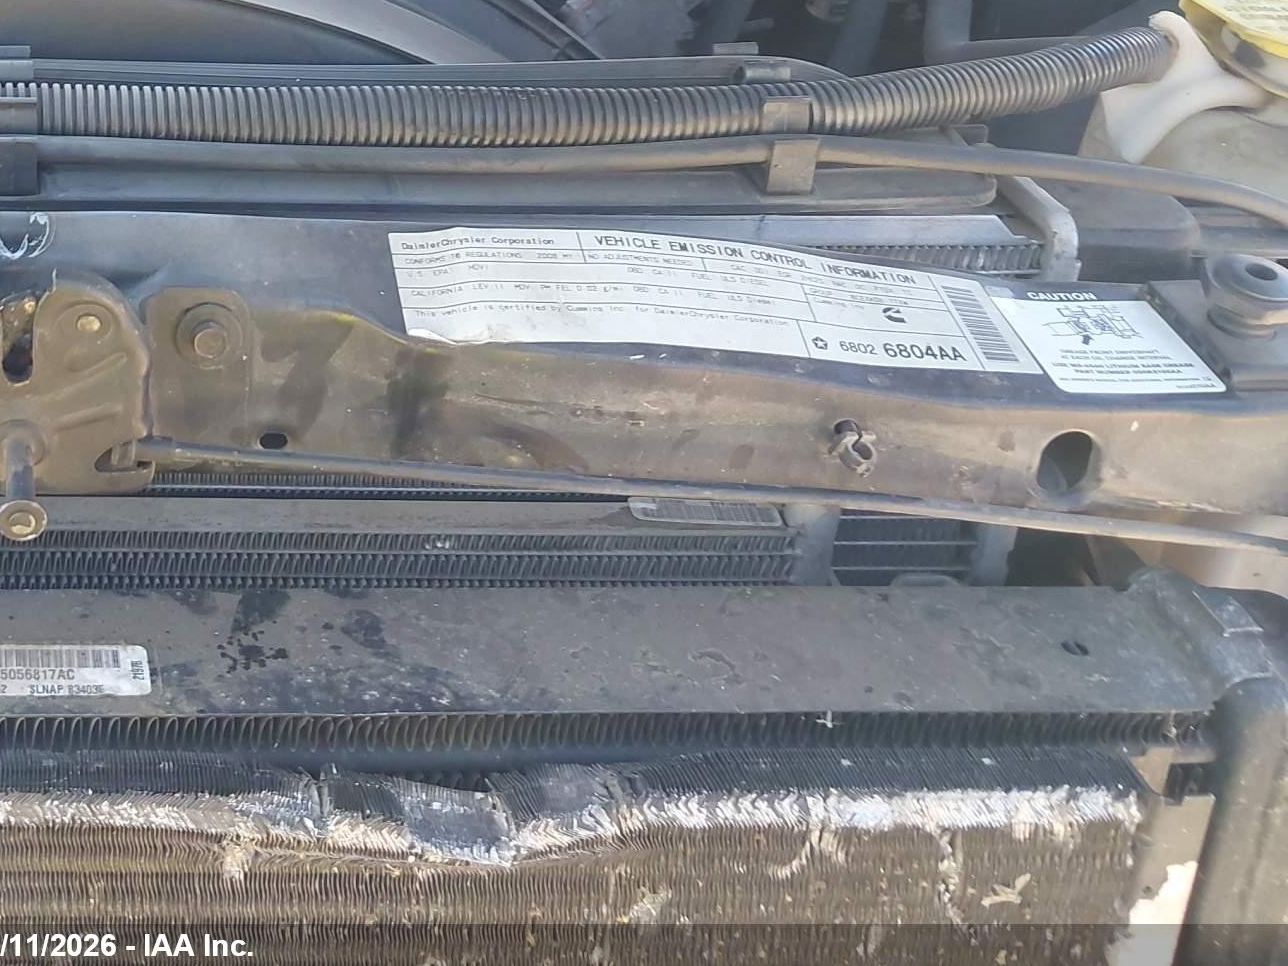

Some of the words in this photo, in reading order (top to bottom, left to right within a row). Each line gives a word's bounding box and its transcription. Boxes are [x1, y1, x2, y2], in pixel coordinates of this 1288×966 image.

[401, 236, 486, 250] DaimlerChrysler
[491, 236, 555, 246] Corporation
[594, 235, 661, 250] VEHICLE
[669, 240, 744, 258] EMISSION
[751, 249, 812, 270] CONTROL
[820, 262, 917, 285] INFORMATION
[1026, 291, 1099, 302] CAUTION
[839, 340, 878, 356] 6802
[882, 341, 968, 362] 6804AA
